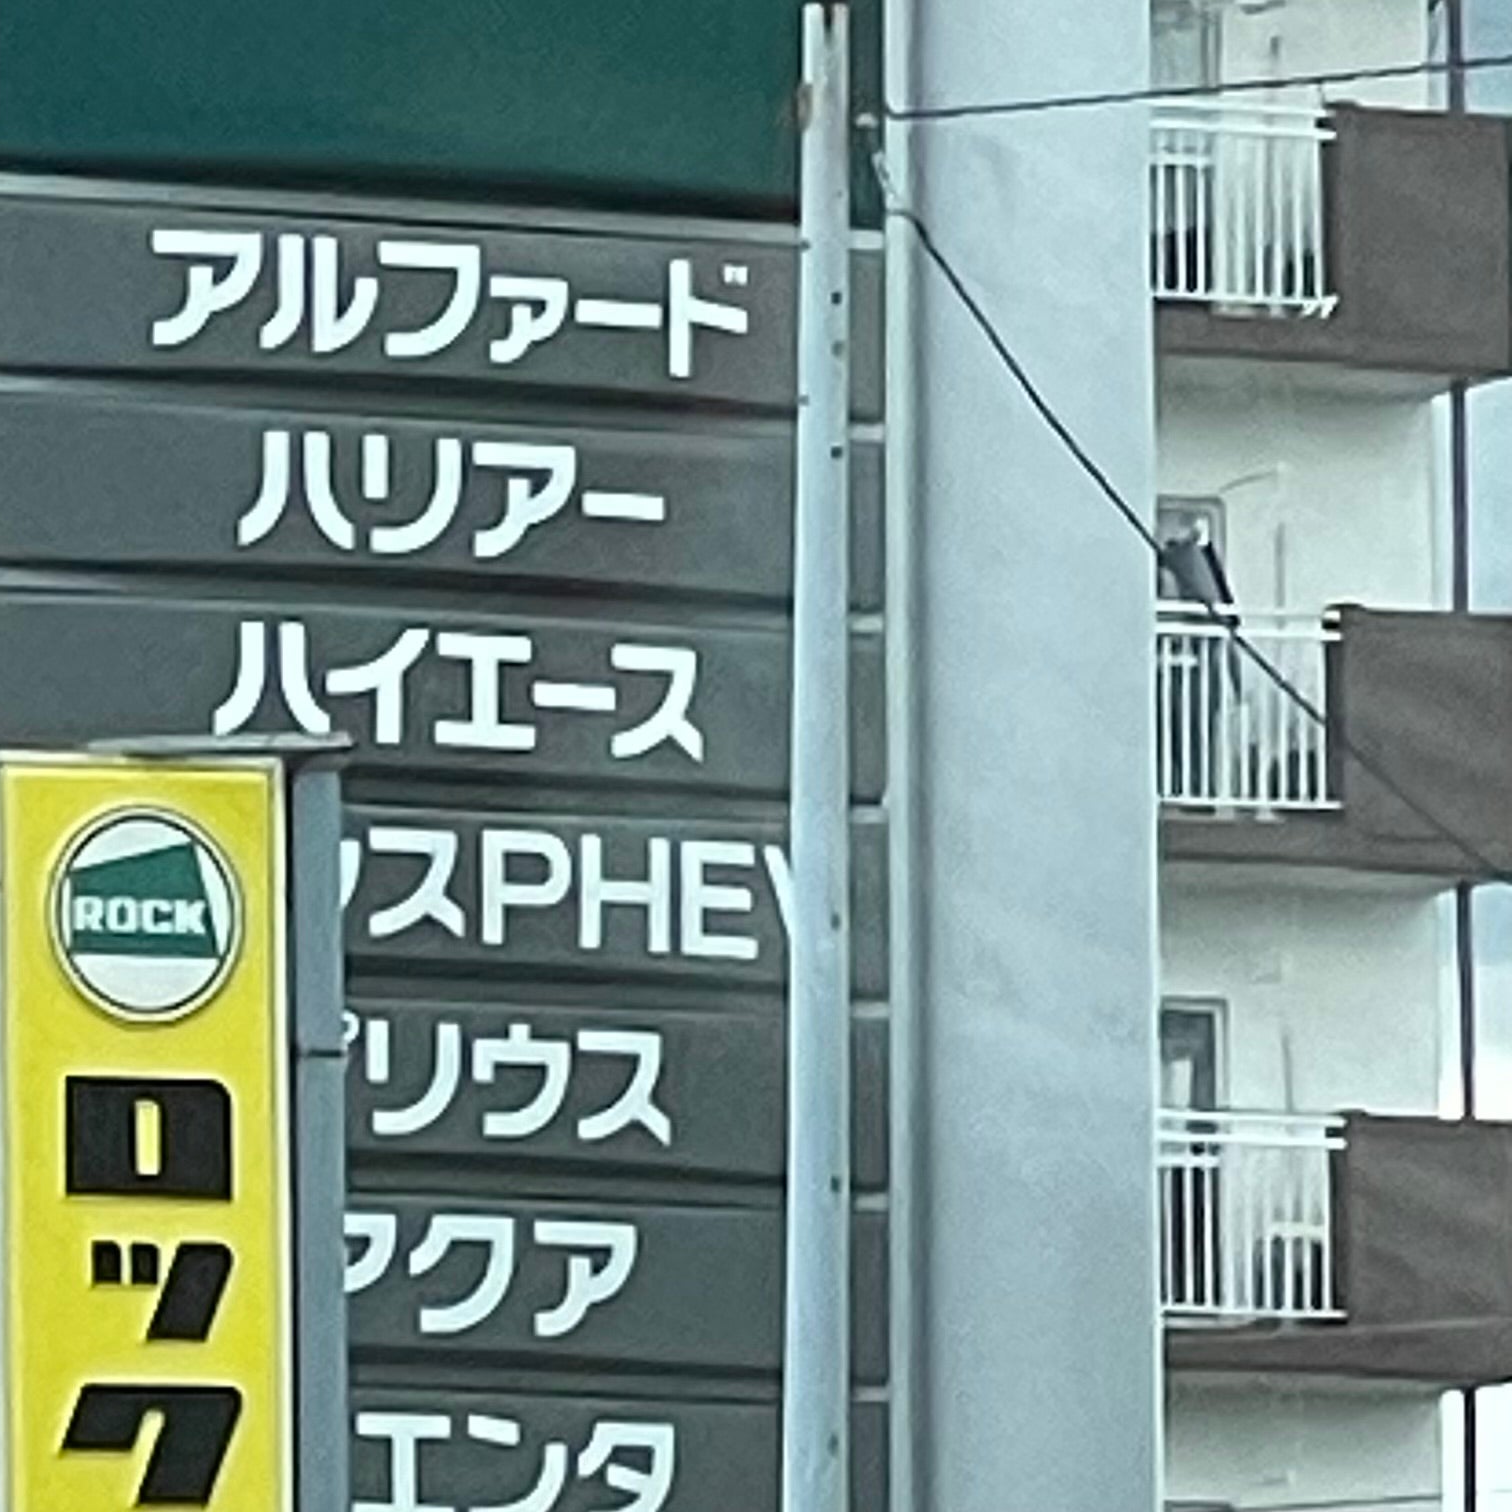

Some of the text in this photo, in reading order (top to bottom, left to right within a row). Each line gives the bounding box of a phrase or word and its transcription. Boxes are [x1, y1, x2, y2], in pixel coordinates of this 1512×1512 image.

[151, 229, 749, 378] アルファード
[238, 430, 665, 558] ハリアー
[214, 621, 704, 763] ハイエース
[72, 895, 207, 935] ROCK
[340, 826, 792, 960] スPHE
[342, 1011, 672, 1146] リウス
[59, 1074, 244, 1508] ロック
